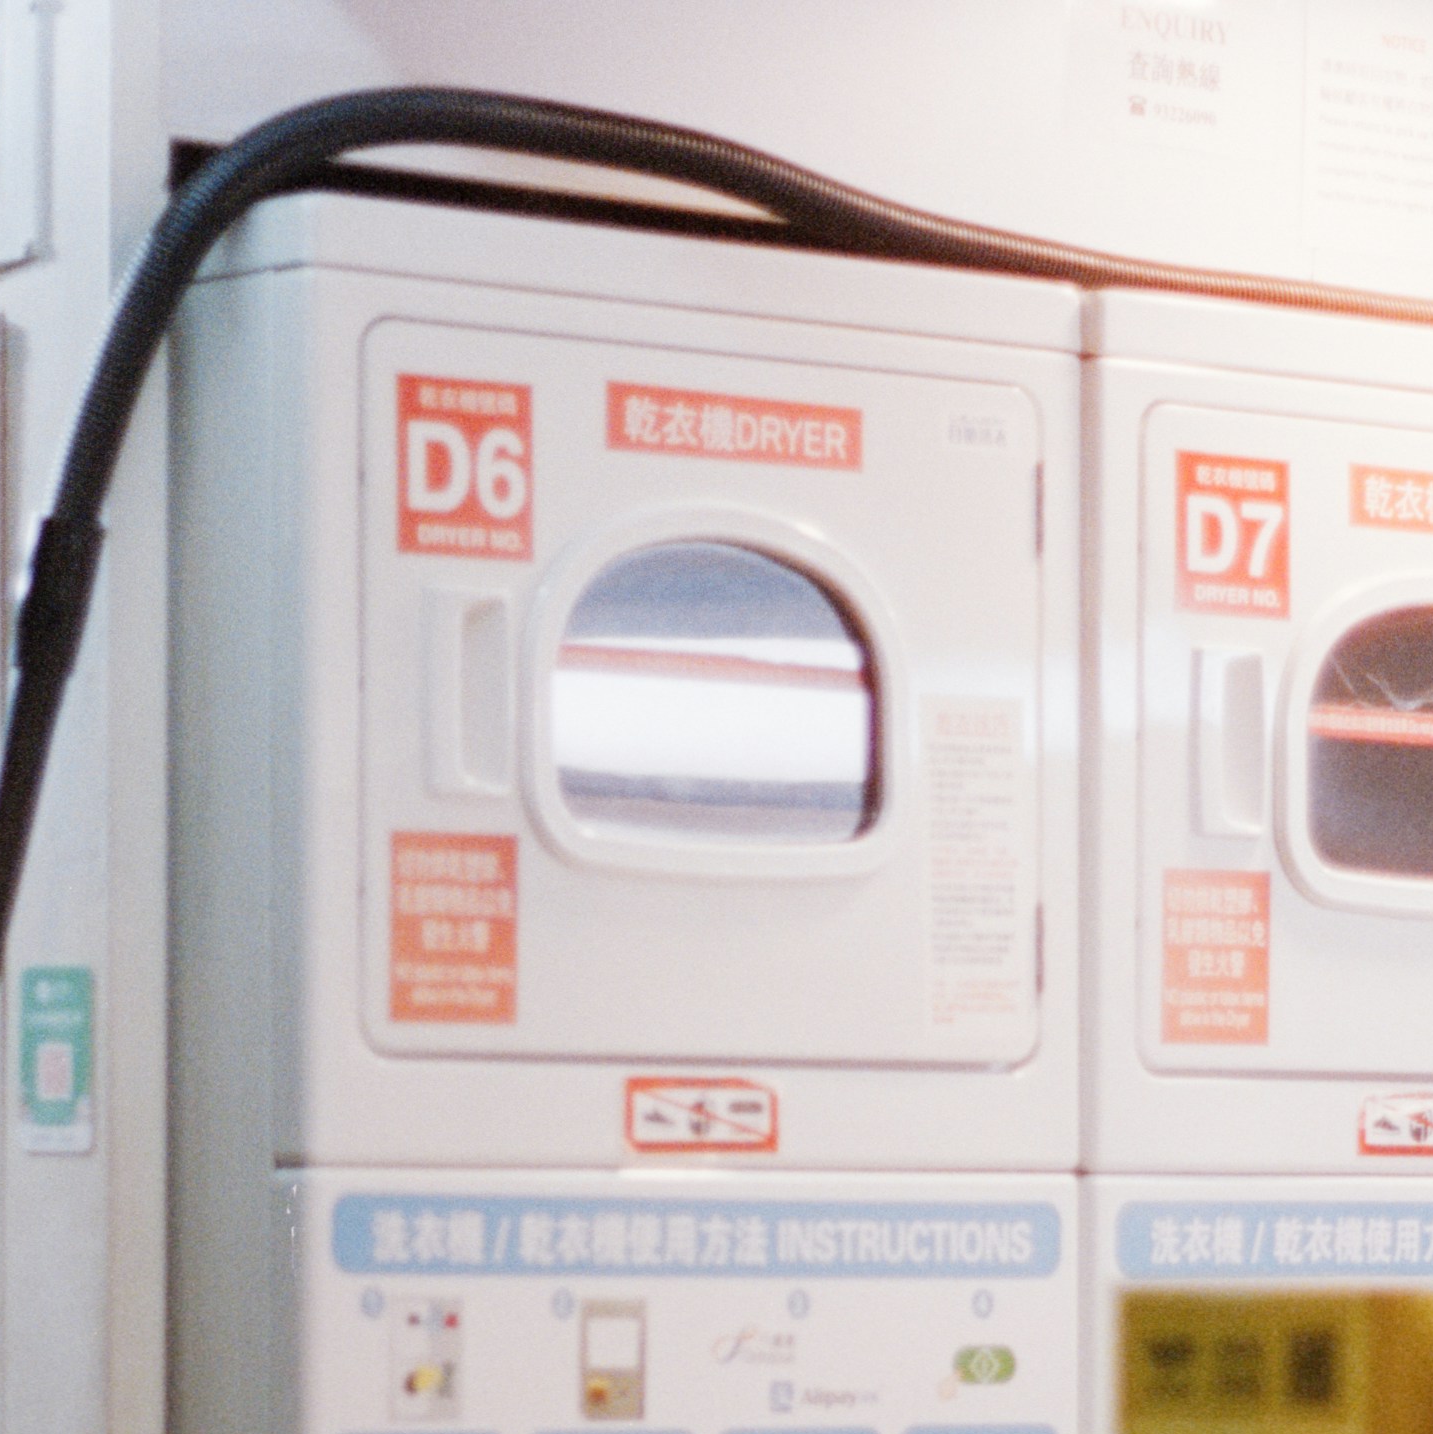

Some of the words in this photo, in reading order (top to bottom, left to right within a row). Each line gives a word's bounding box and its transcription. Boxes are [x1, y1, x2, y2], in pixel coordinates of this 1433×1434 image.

[1119, 5, 1228, 45] ENQUIRY
[1128, 50, 1221, 91] 查詢熱線
[406, 418, 527, 521] D6
[416, 522, 486, 549] DRYER
[1186, 494, 1285, 580] D7
[1194, 584, 1249, 606] DRYER
[776, 1219, 1032, 1266] INSTRUCTIONS
[1150, 1215, 1245, 1264] 洗衣機
